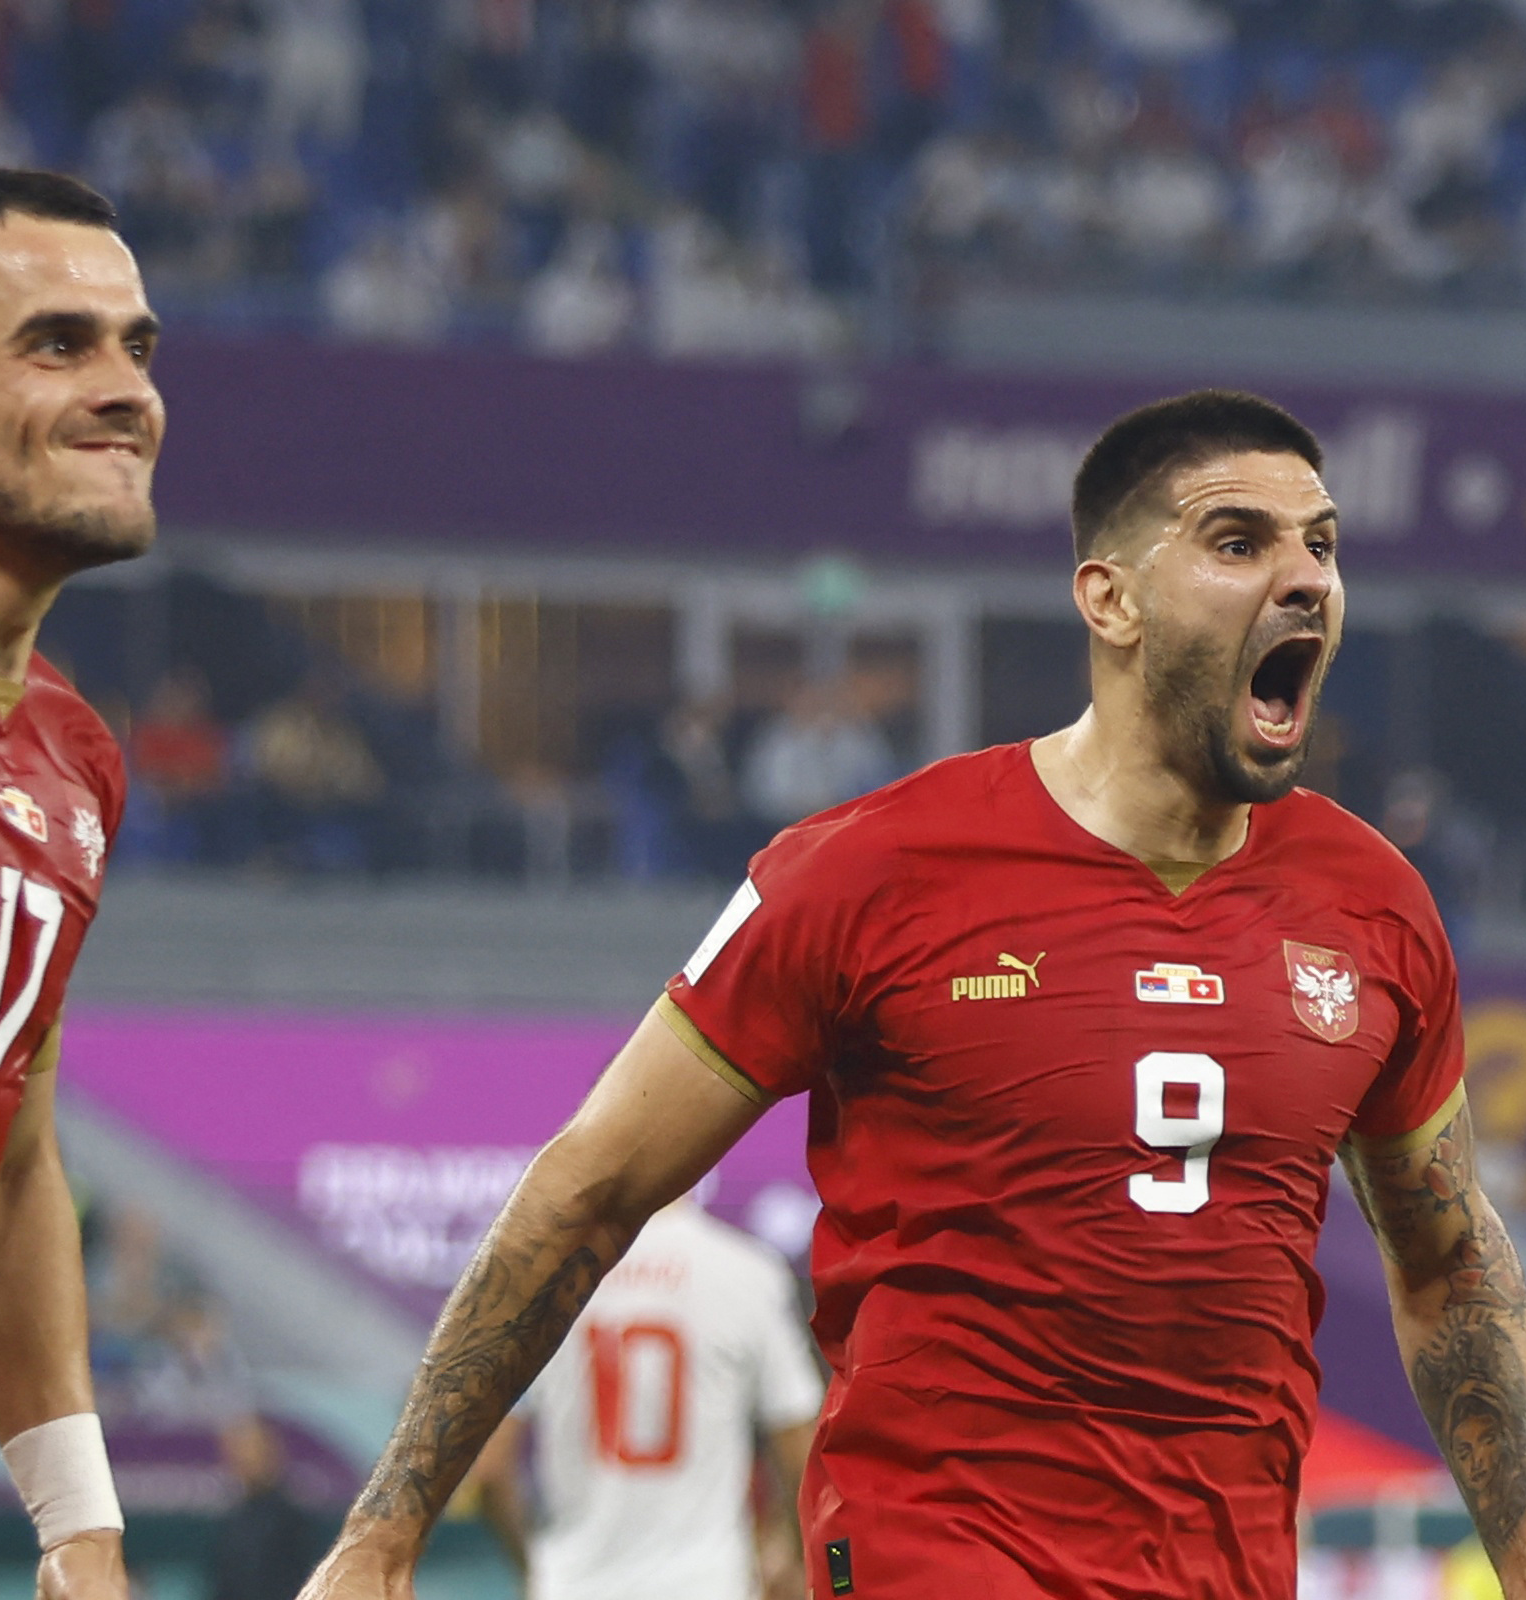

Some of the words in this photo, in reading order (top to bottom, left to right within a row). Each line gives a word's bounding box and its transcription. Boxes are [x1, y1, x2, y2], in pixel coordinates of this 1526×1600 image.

[952, 973, 1026, 1001] PUMA
[1128, 1051, 1226, 1213] 9
[587, 1322, 687, 1468] 10
